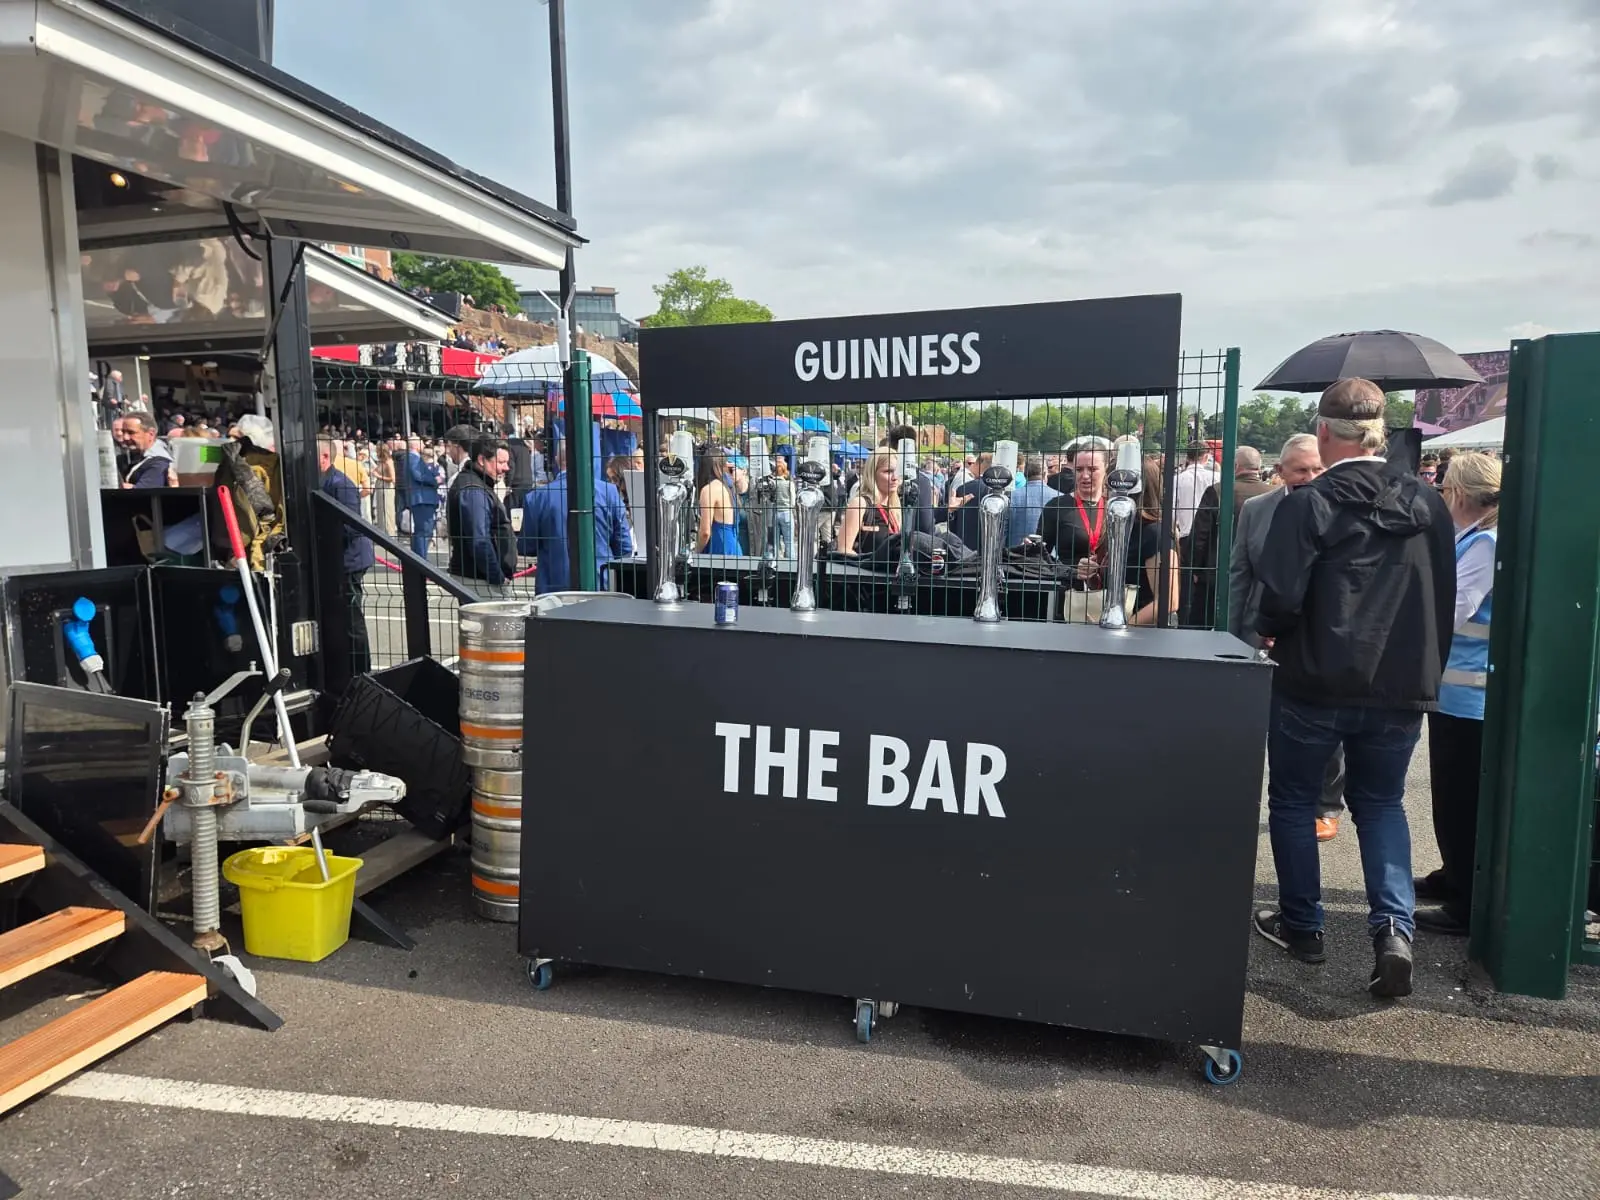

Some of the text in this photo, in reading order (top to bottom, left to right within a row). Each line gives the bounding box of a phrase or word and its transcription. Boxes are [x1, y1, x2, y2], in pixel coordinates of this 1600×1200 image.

[795, 332, 981, 382] GUINNESS
[715, 721, 1007, 818] THE BAR
